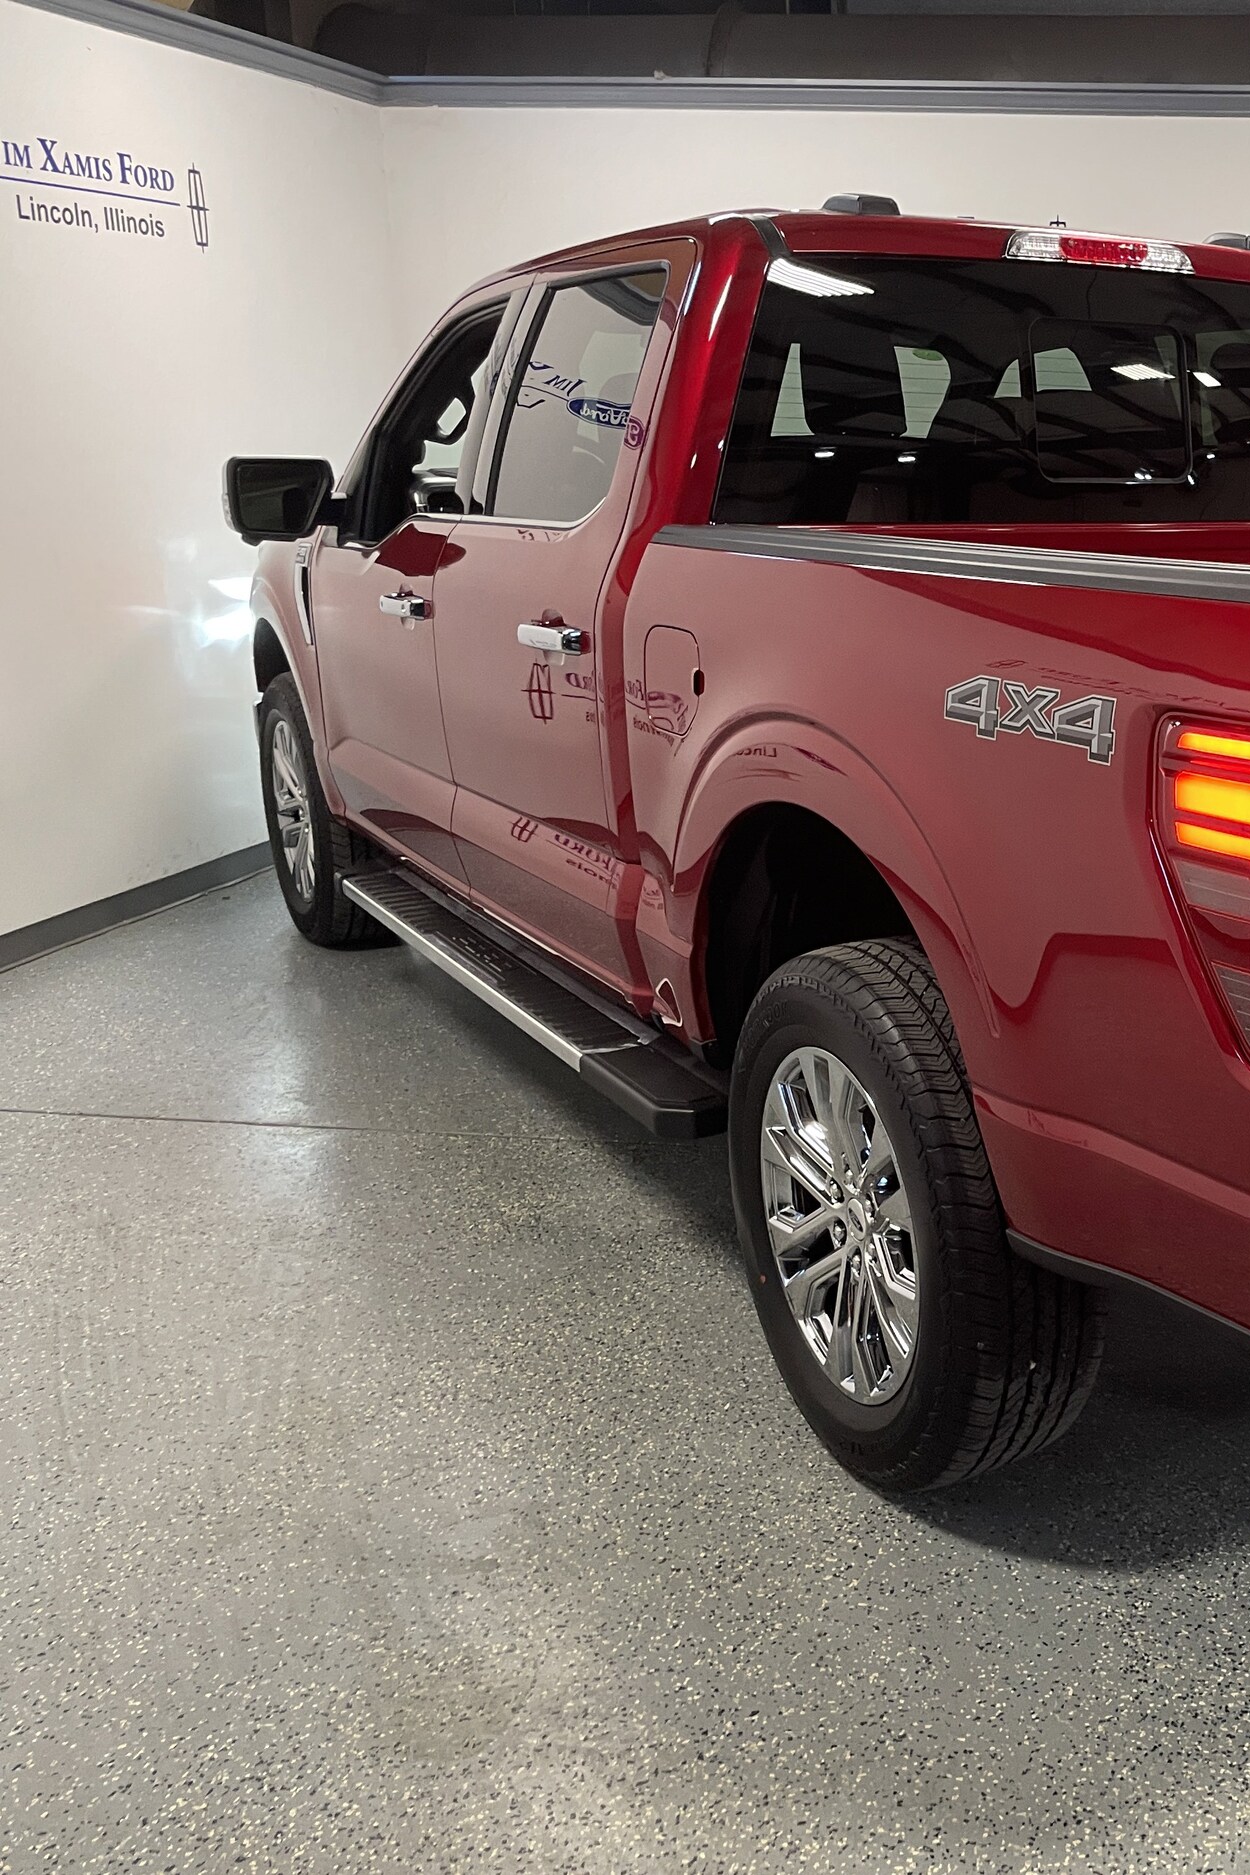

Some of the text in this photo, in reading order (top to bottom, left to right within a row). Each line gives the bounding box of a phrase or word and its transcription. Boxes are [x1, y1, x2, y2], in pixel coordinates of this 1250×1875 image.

[2, 137, 175, 192] IM XAMIS FORD
[16, 194, 165, 238] Lincoln, Illinois
